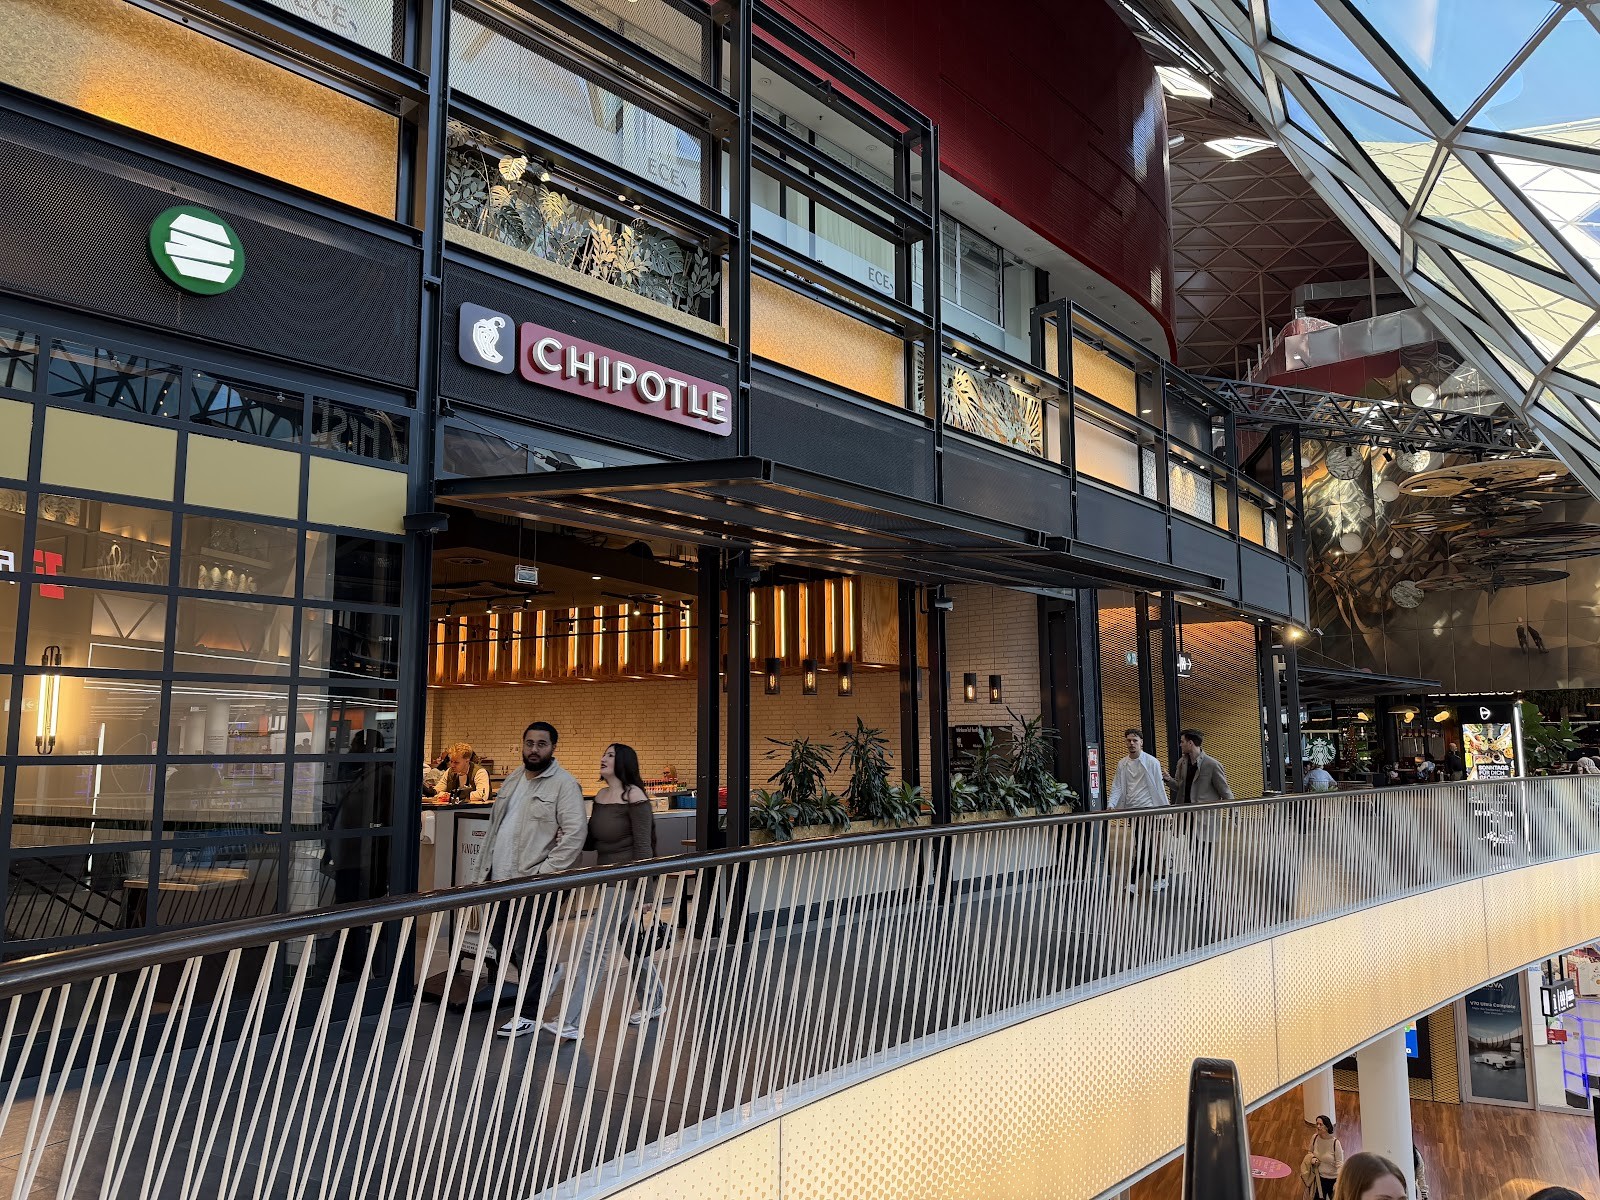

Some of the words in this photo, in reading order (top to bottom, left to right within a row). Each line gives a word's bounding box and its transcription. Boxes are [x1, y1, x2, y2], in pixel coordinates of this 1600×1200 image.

[649, 157, 680, 187] ECE
[868, 266, 889, 290] ECE
[532, 337, 729, 425] CHIPOTLE
